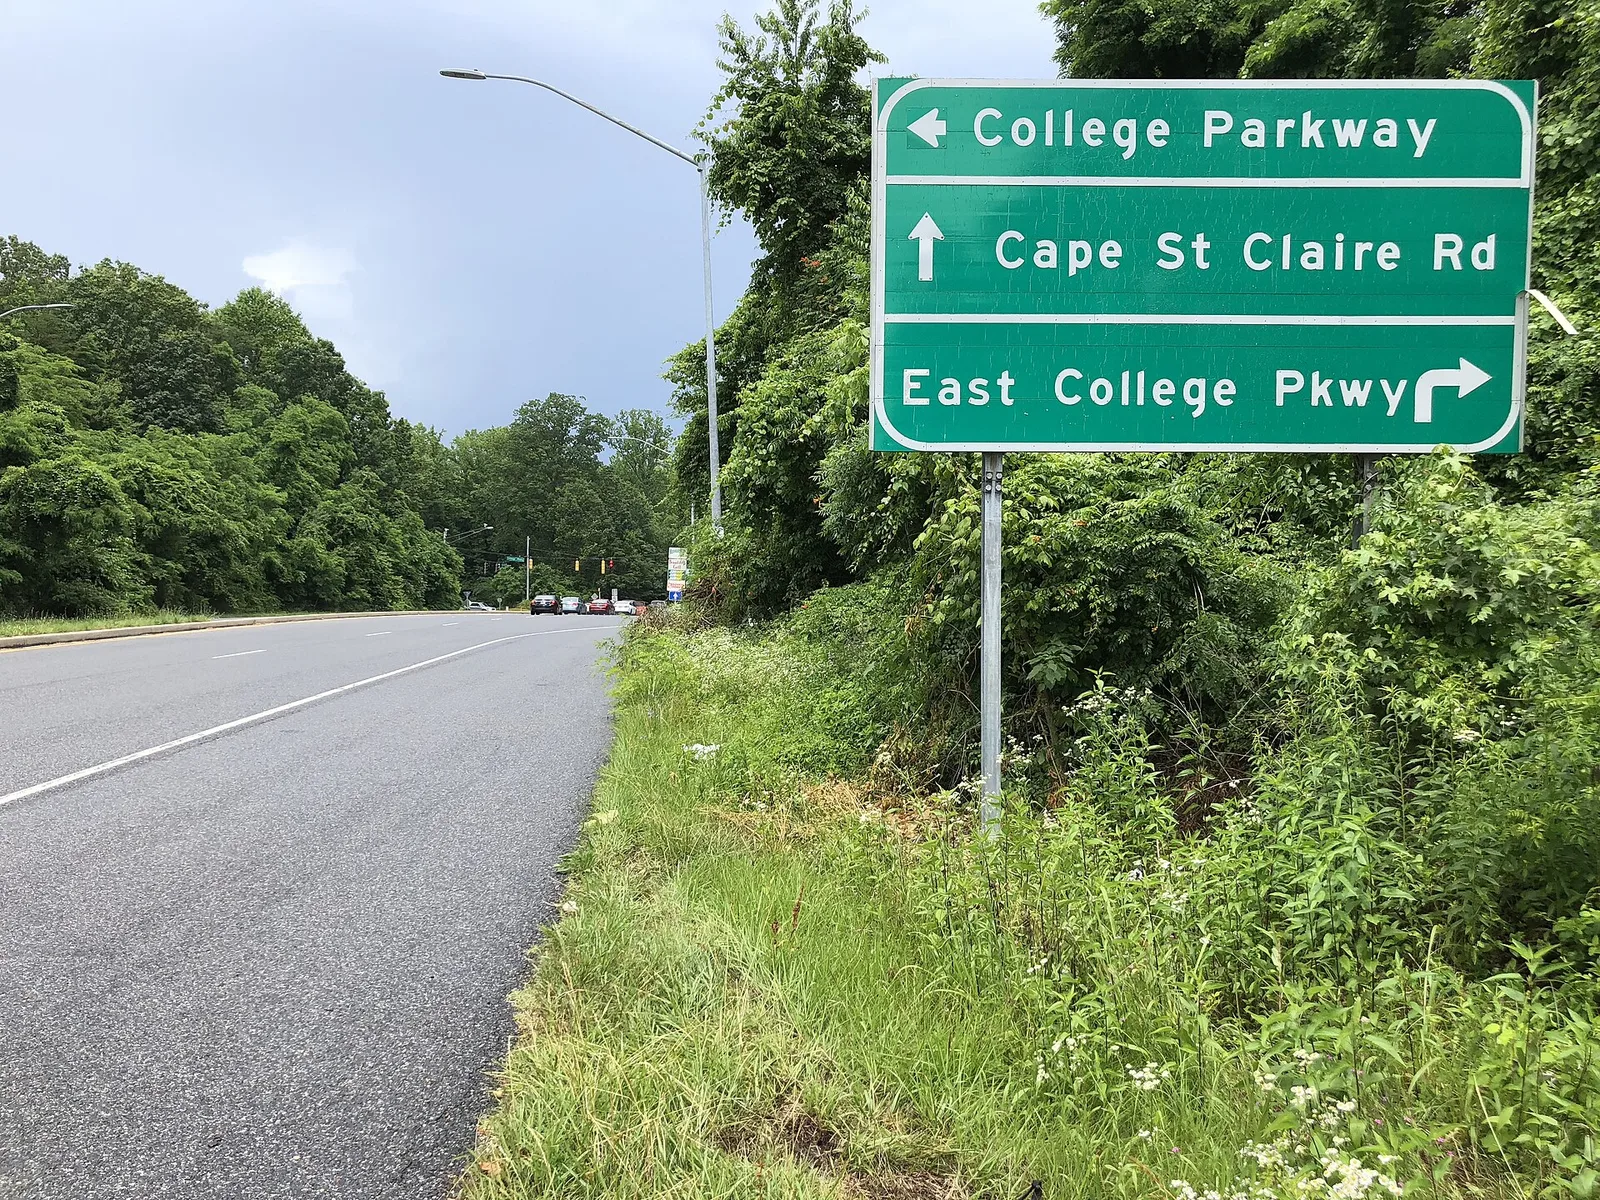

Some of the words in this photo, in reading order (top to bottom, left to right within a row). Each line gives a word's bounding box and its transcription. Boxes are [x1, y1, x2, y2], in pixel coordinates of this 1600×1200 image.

[974, 108, 1169, 159] College
[1204, 110, 1436, 158] Parkway
[996, 231, 1122, 276] Cape
[1157, 233, 1211, 270] St
[1244, 233, 1400, 271] Claire
[1434, 233, 1495, 271] Rd
[903, 369, 1014, 406] East
[1055, 369, 1236, 417] College
[1276, 370, 1407, 417] Pkwy
